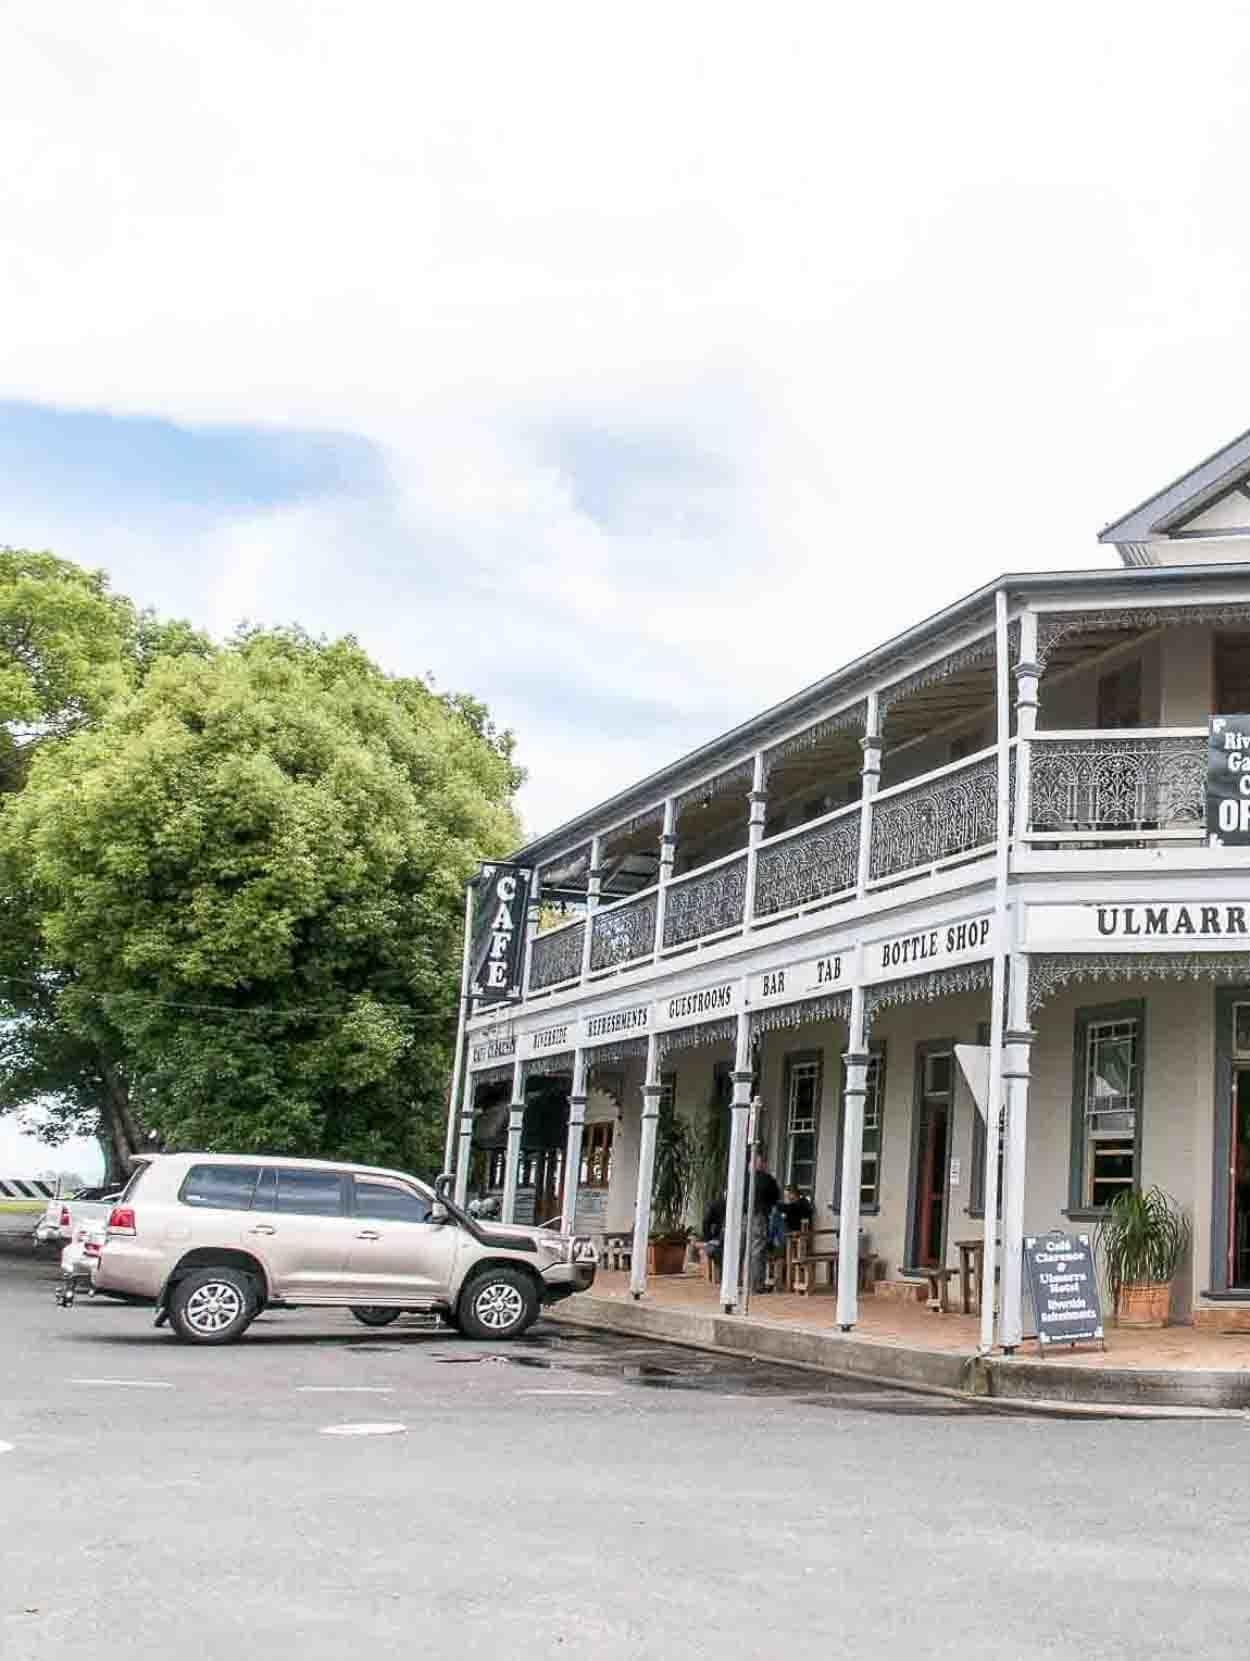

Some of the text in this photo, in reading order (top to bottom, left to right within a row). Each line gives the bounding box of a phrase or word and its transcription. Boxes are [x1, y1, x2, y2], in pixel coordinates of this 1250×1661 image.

[487, 876, 517, 988] CAFE
[881, 918, 990, 967] BOTTLE SHOP
[762, 956, 841, 997] BAR TAB
[669, 985, 732, 1019] GUESTROOMS
